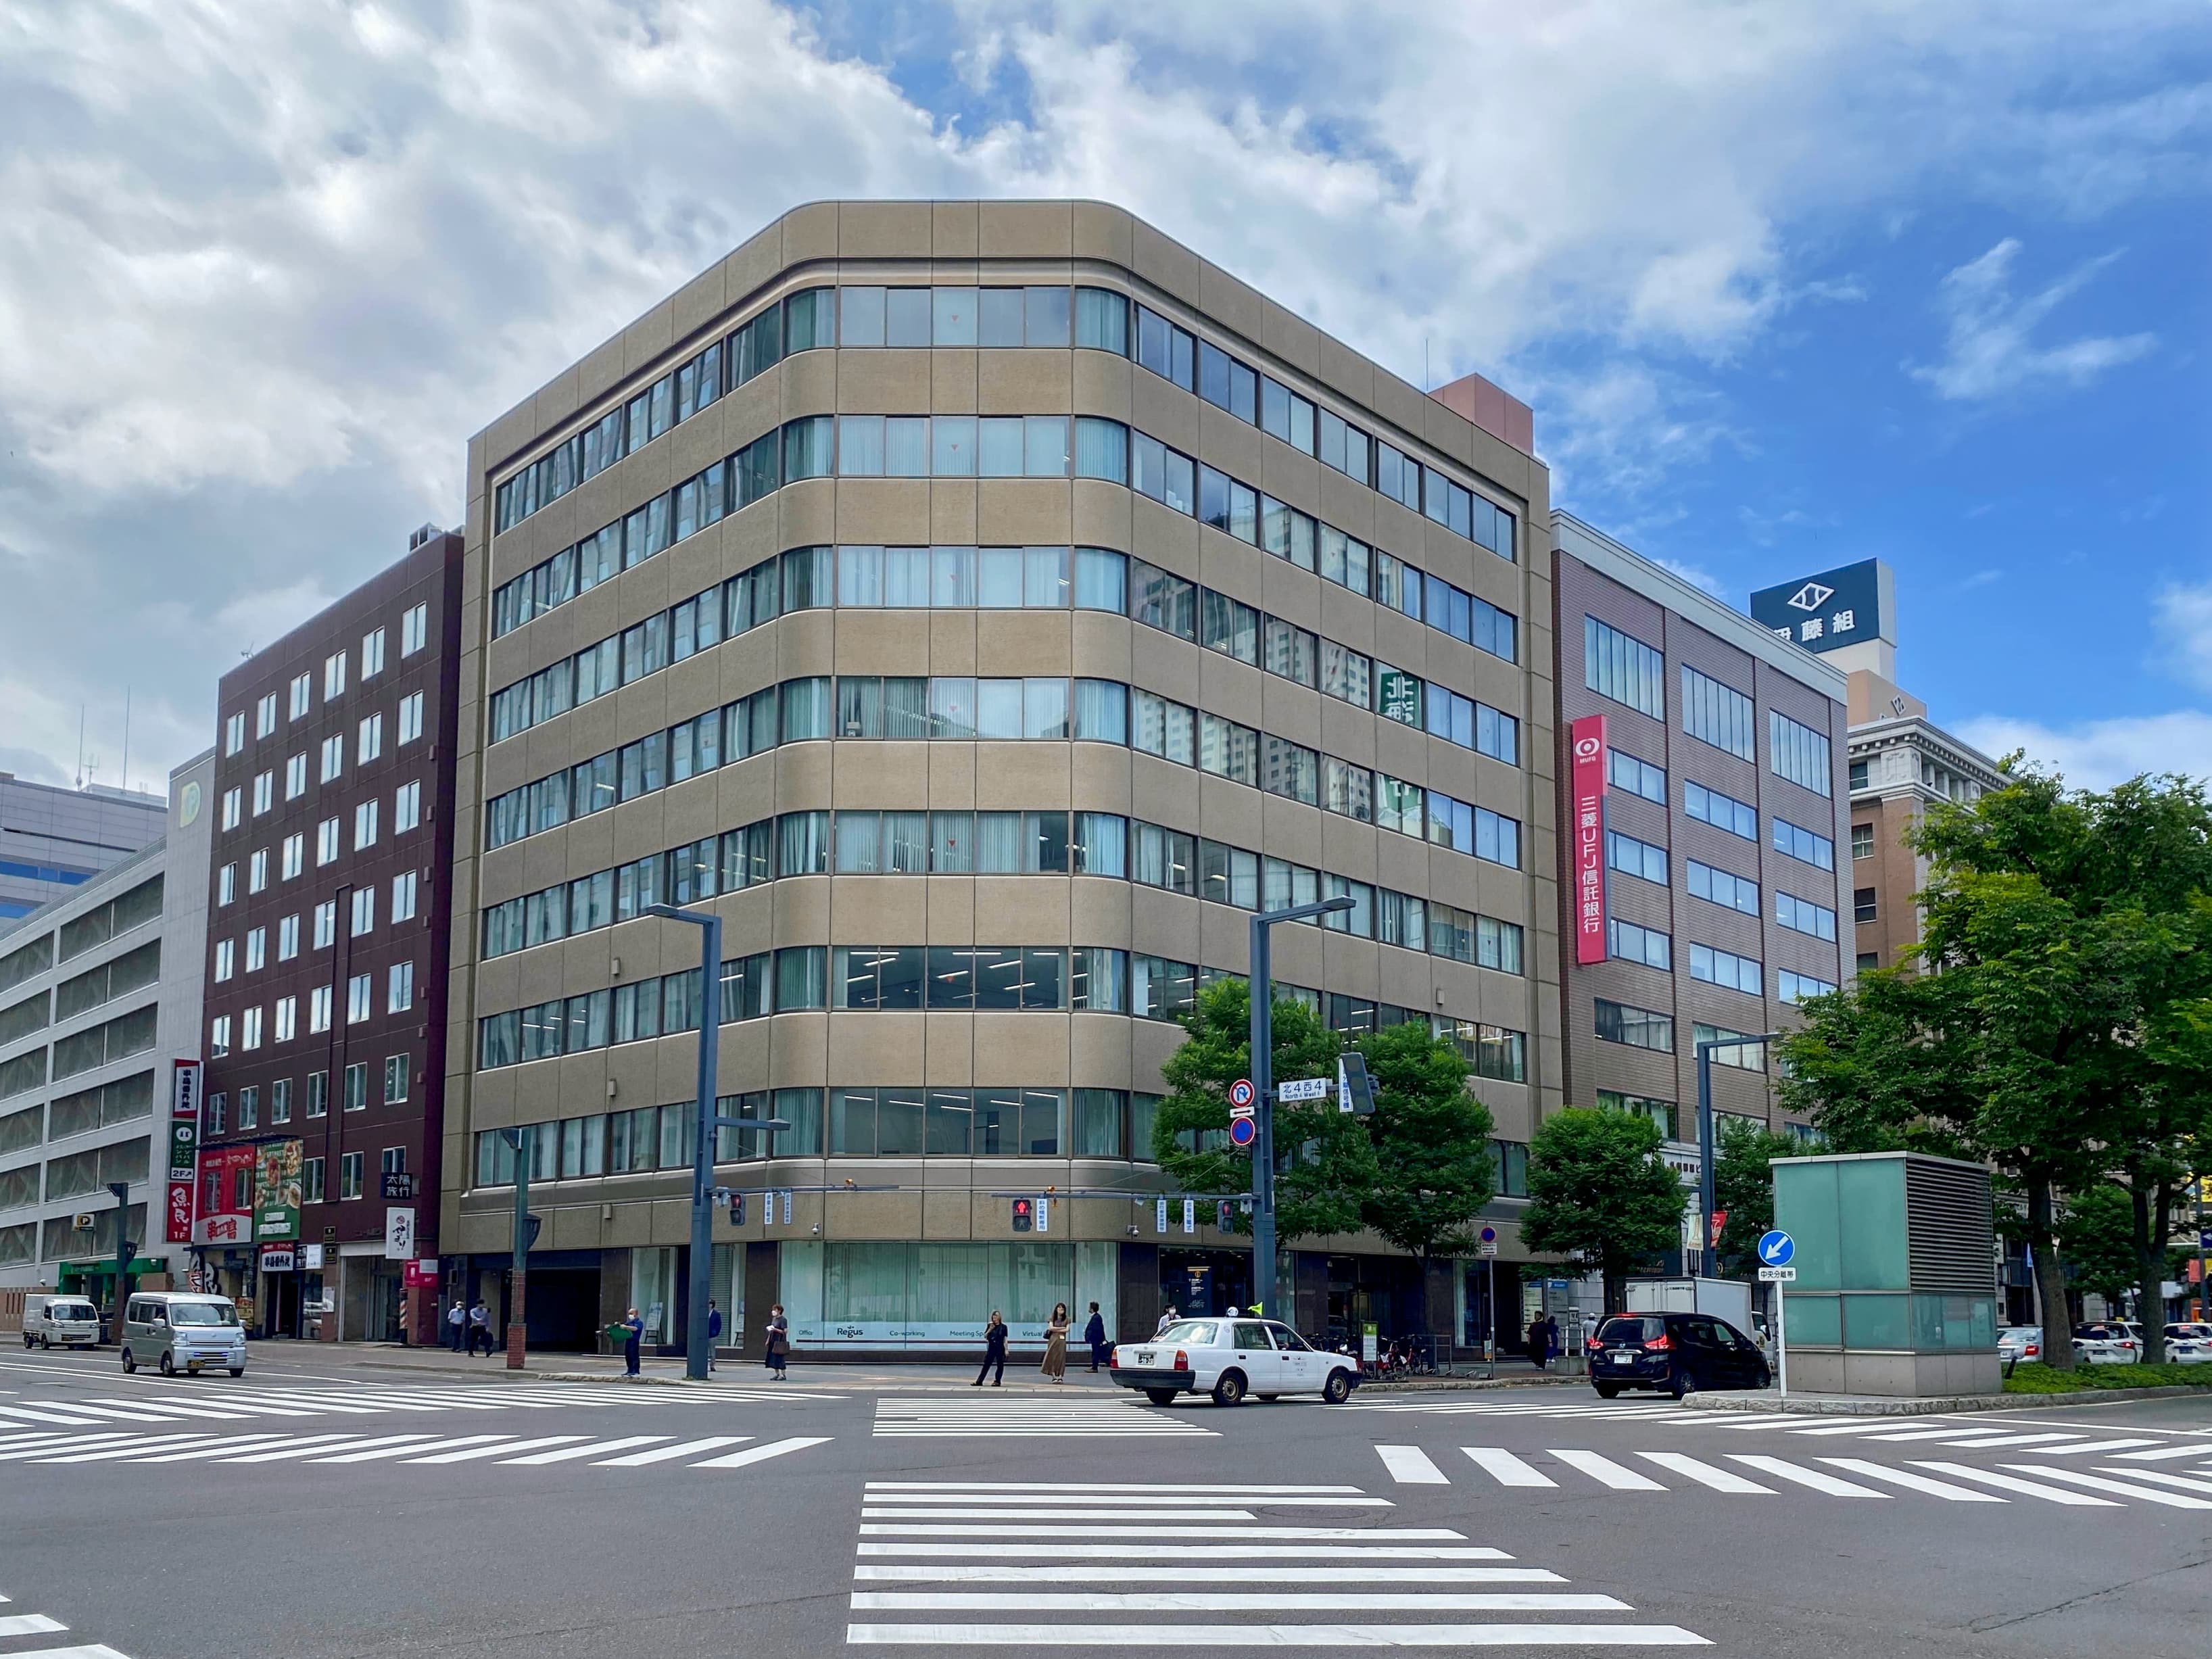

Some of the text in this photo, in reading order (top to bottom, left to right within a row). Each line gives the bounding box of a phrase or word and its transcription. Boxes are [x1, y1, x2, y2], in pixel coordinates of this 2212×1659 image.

[1579, 756, 1596, 764] MUFG
[1581, 796, 1600, 934] 三菱UFJ信託銀行
[387, 1174, 410, 1186] 太陽
[386, 1186, 410, 1197] 旅行
[174, 1231, 186, 1239] 1F
[1760, 1270, 1794, 1278] 中央分離帯
[837, 1327, 864, 1339] Regus
